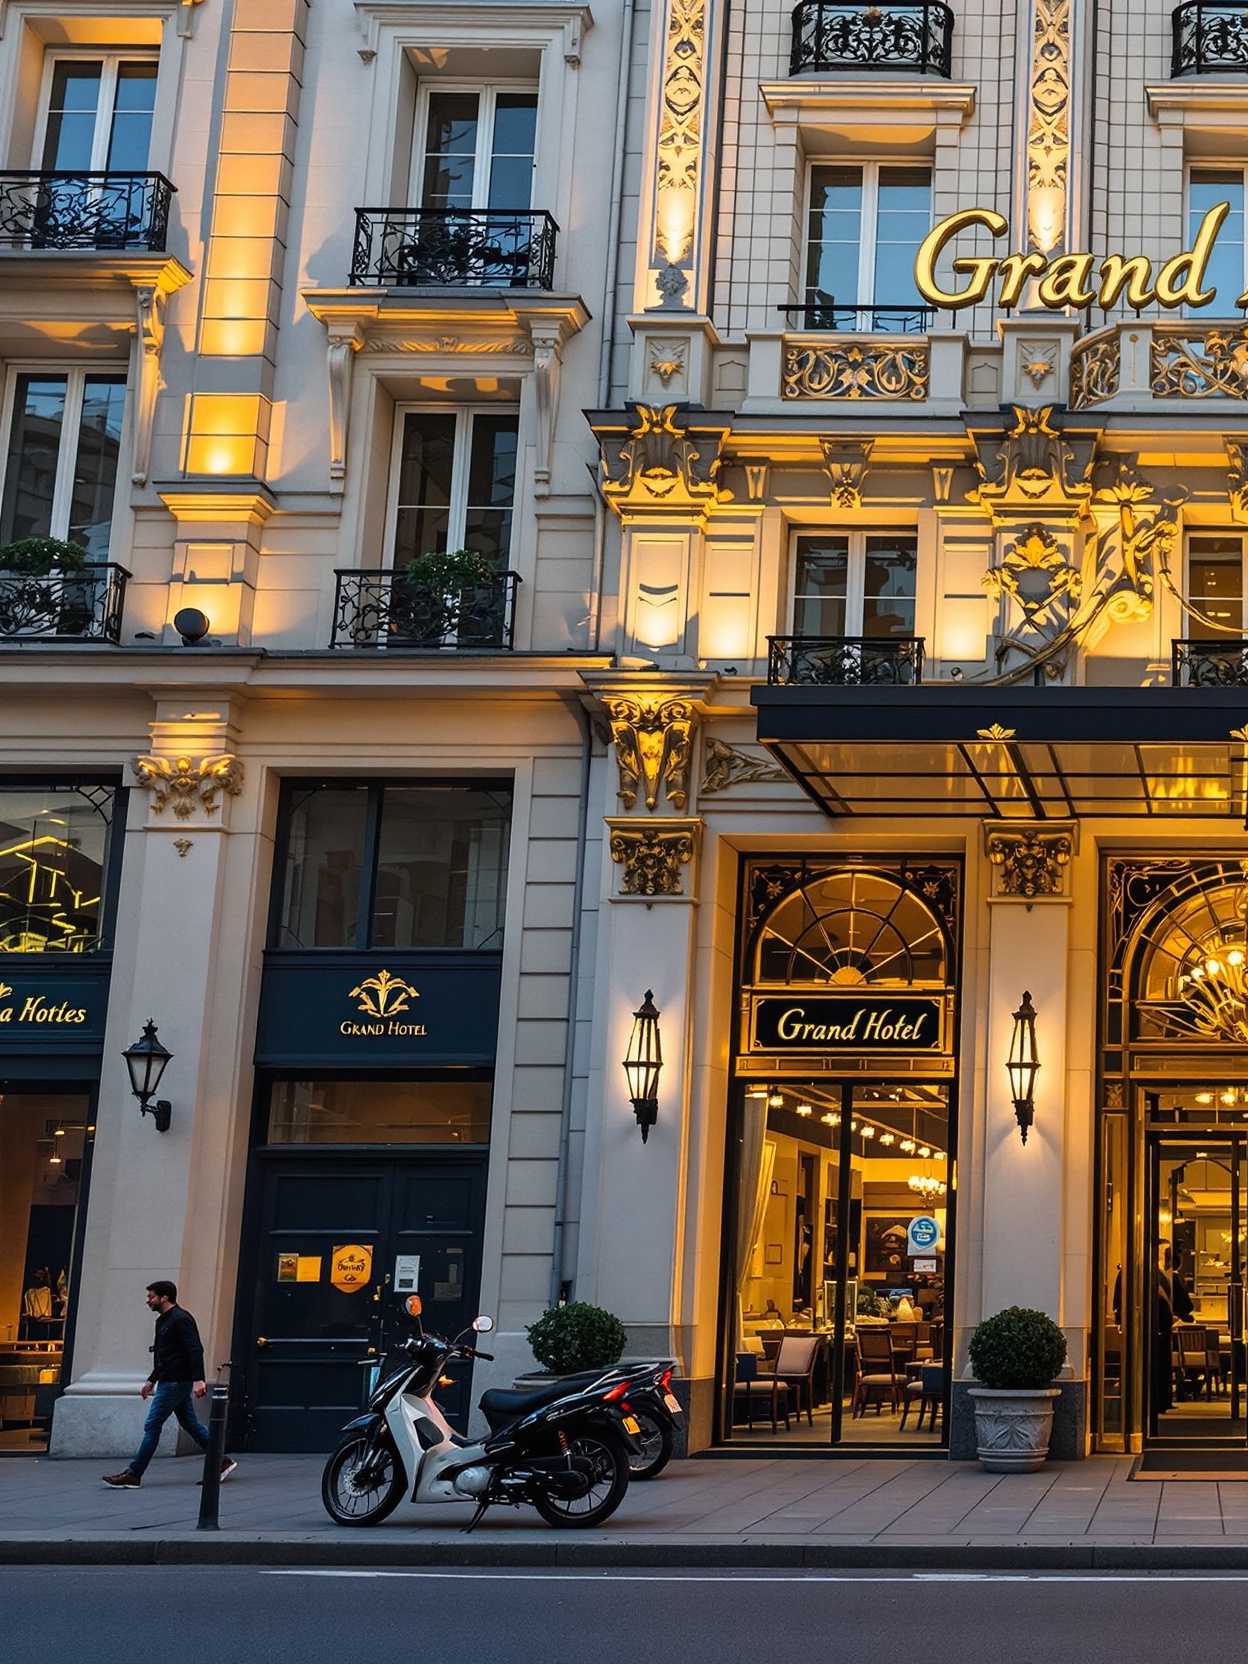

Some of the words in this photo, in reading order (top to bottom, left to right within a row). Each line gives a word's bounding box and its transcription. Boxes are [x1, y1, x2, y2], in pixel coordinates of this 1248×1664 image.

[914, 201, 1231, 310] Grand
[777, 1008, 867, 1040] Grand
[862, 1009, 928, 1040] Hotel
